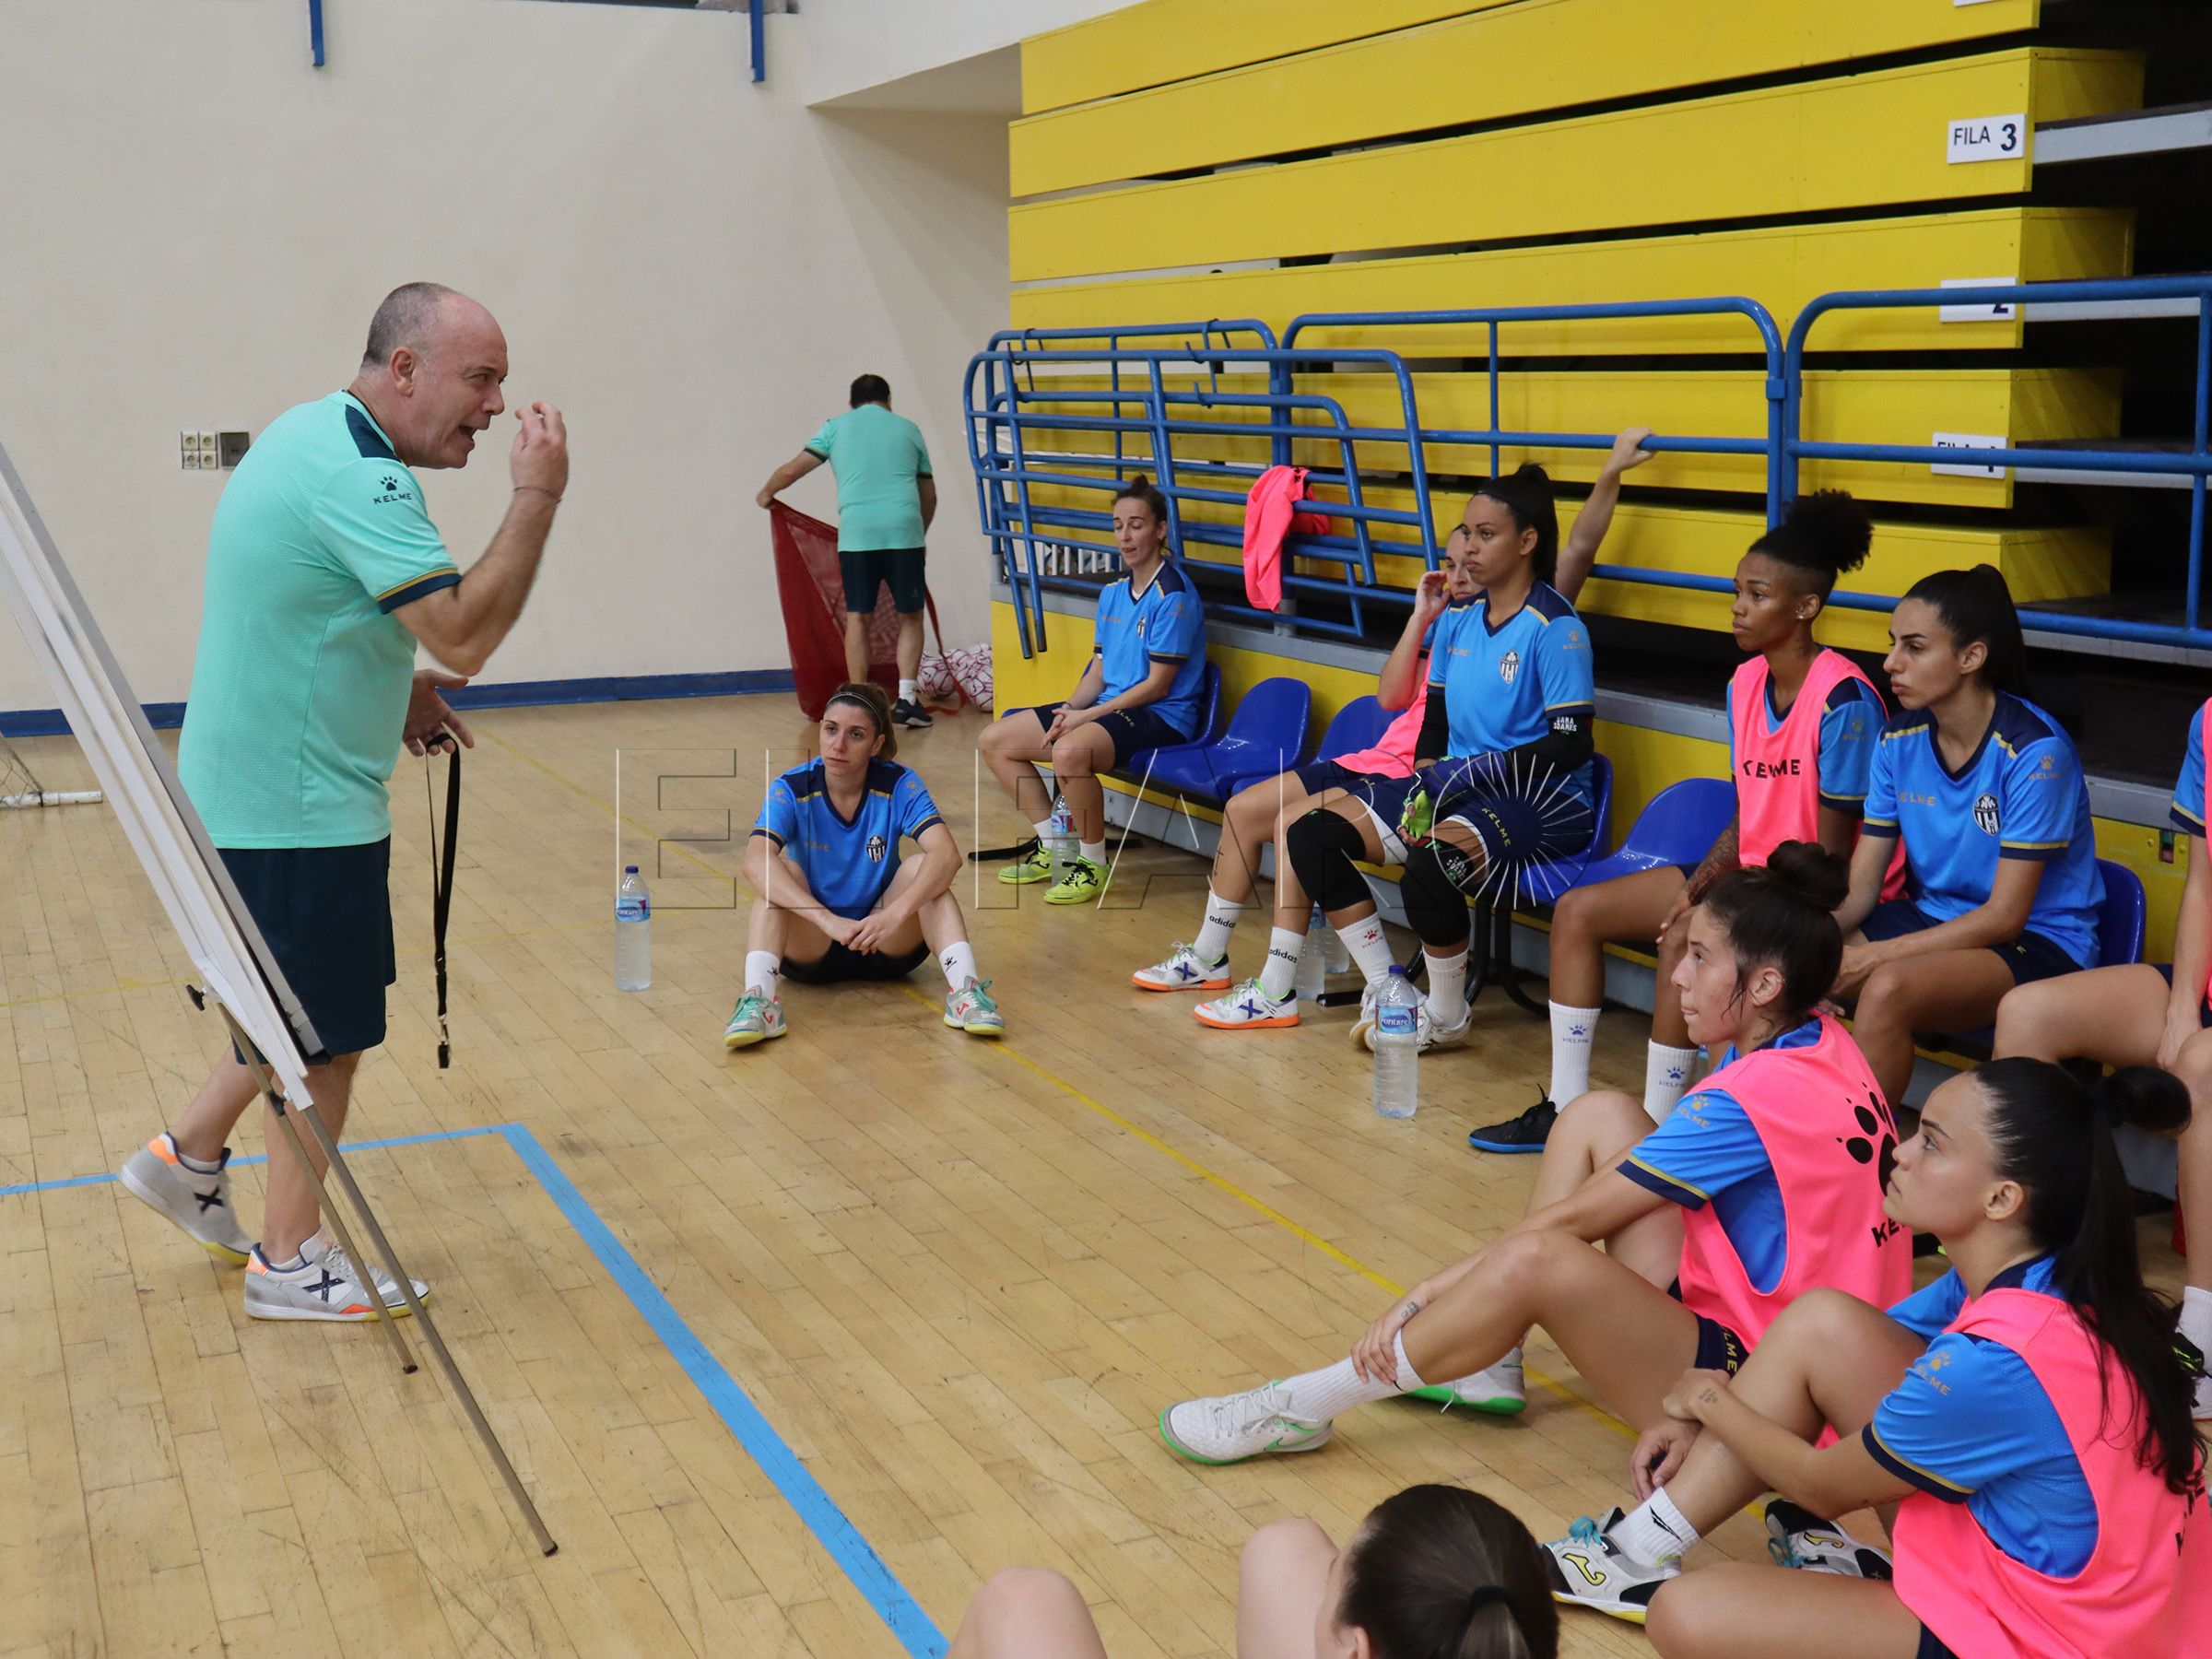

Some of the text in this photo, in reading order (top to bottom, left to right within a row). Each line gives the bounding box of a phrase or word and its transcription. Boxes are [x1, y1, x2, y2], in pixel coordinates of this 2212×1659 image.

[1953, 123, 2018, 152] FILA 3
[372, 492, 413, 505] KELME
[1898, 792, 1936, 806] ELME
[1480, 806, 1512, 848] KELME
[1209, 914, 1237, 929] adida
[1724, 1328, 1738, 1372] LME
